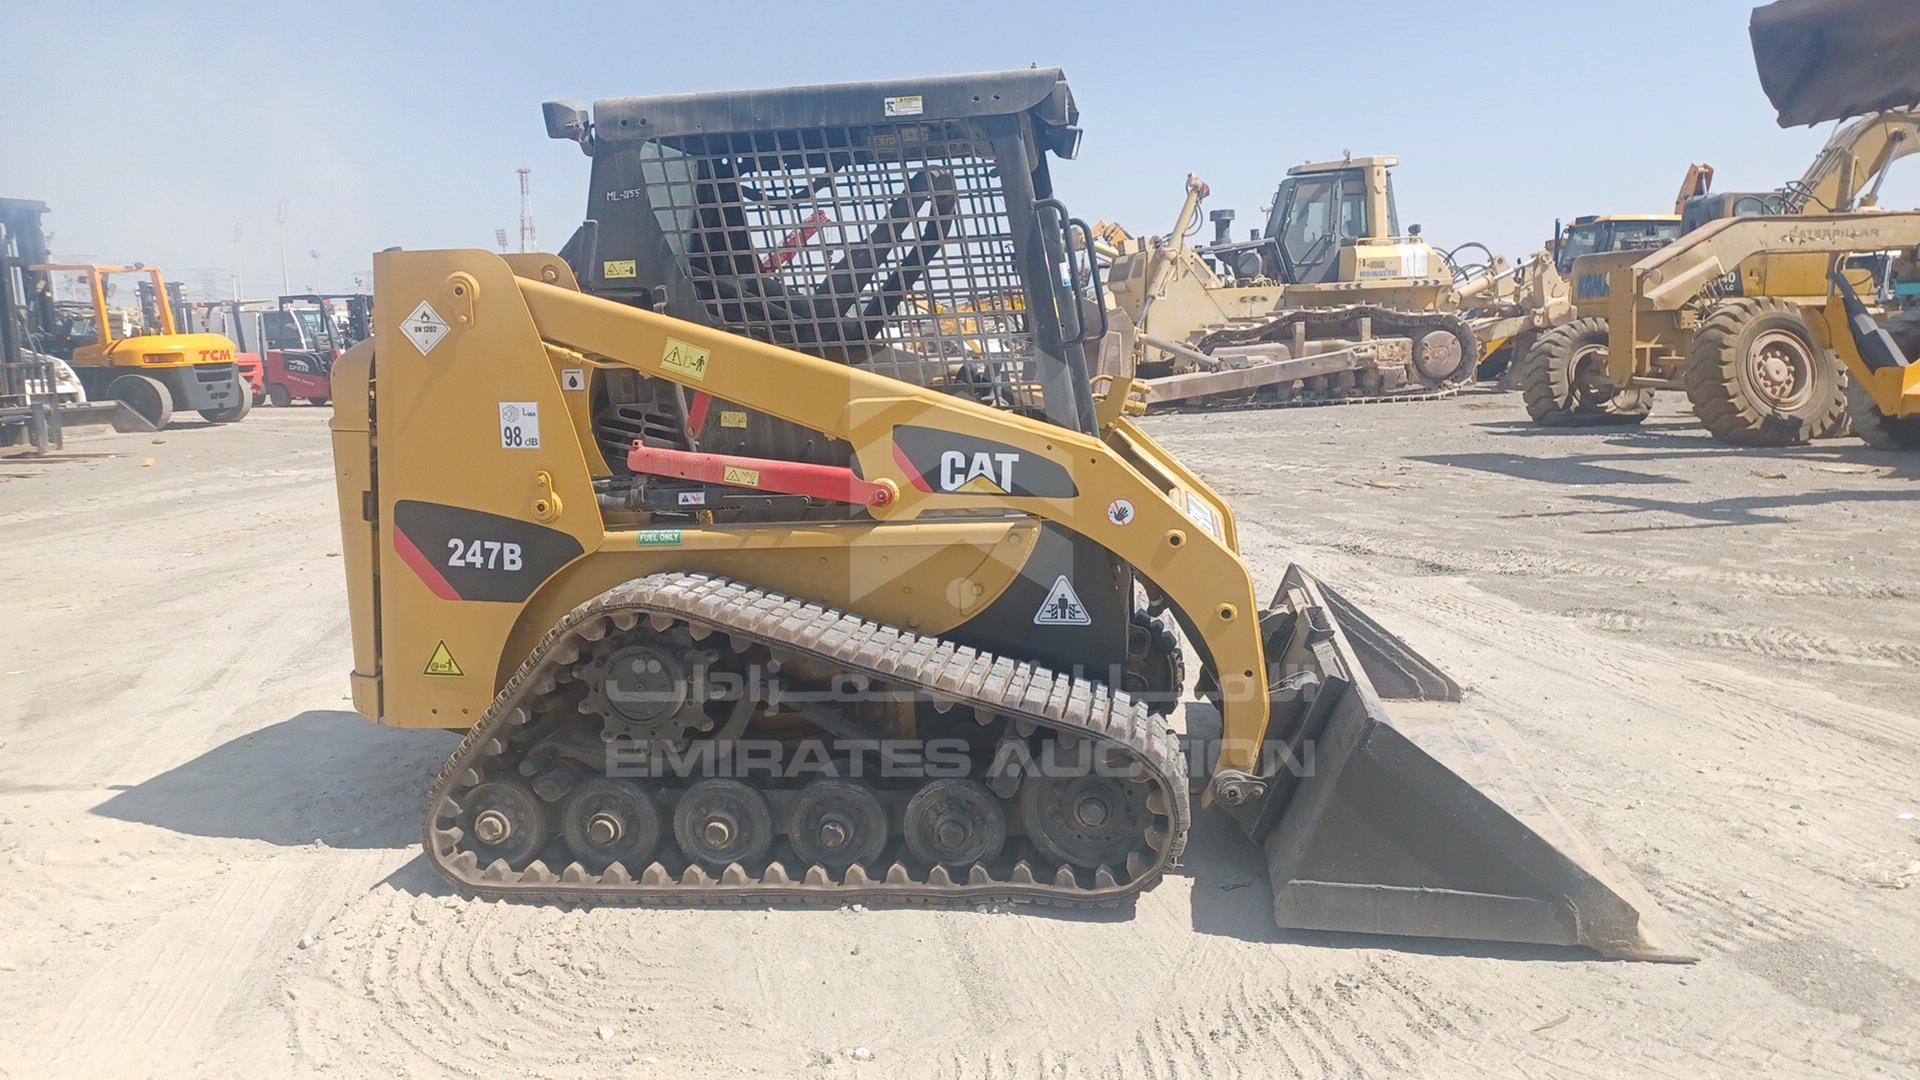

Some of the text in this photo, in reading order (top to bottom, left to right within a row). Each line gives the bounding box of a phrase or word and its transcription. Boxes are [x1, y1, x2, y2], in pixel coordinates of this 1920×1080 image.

[198, 350, 231, 361] TCM
[504, 426, 538, 446] 98 dB
[940, 450, 1020, 493] CAT
[640, 532, 679, 542] FUEL ONLY
[448, 537, 523, 571] 247B
